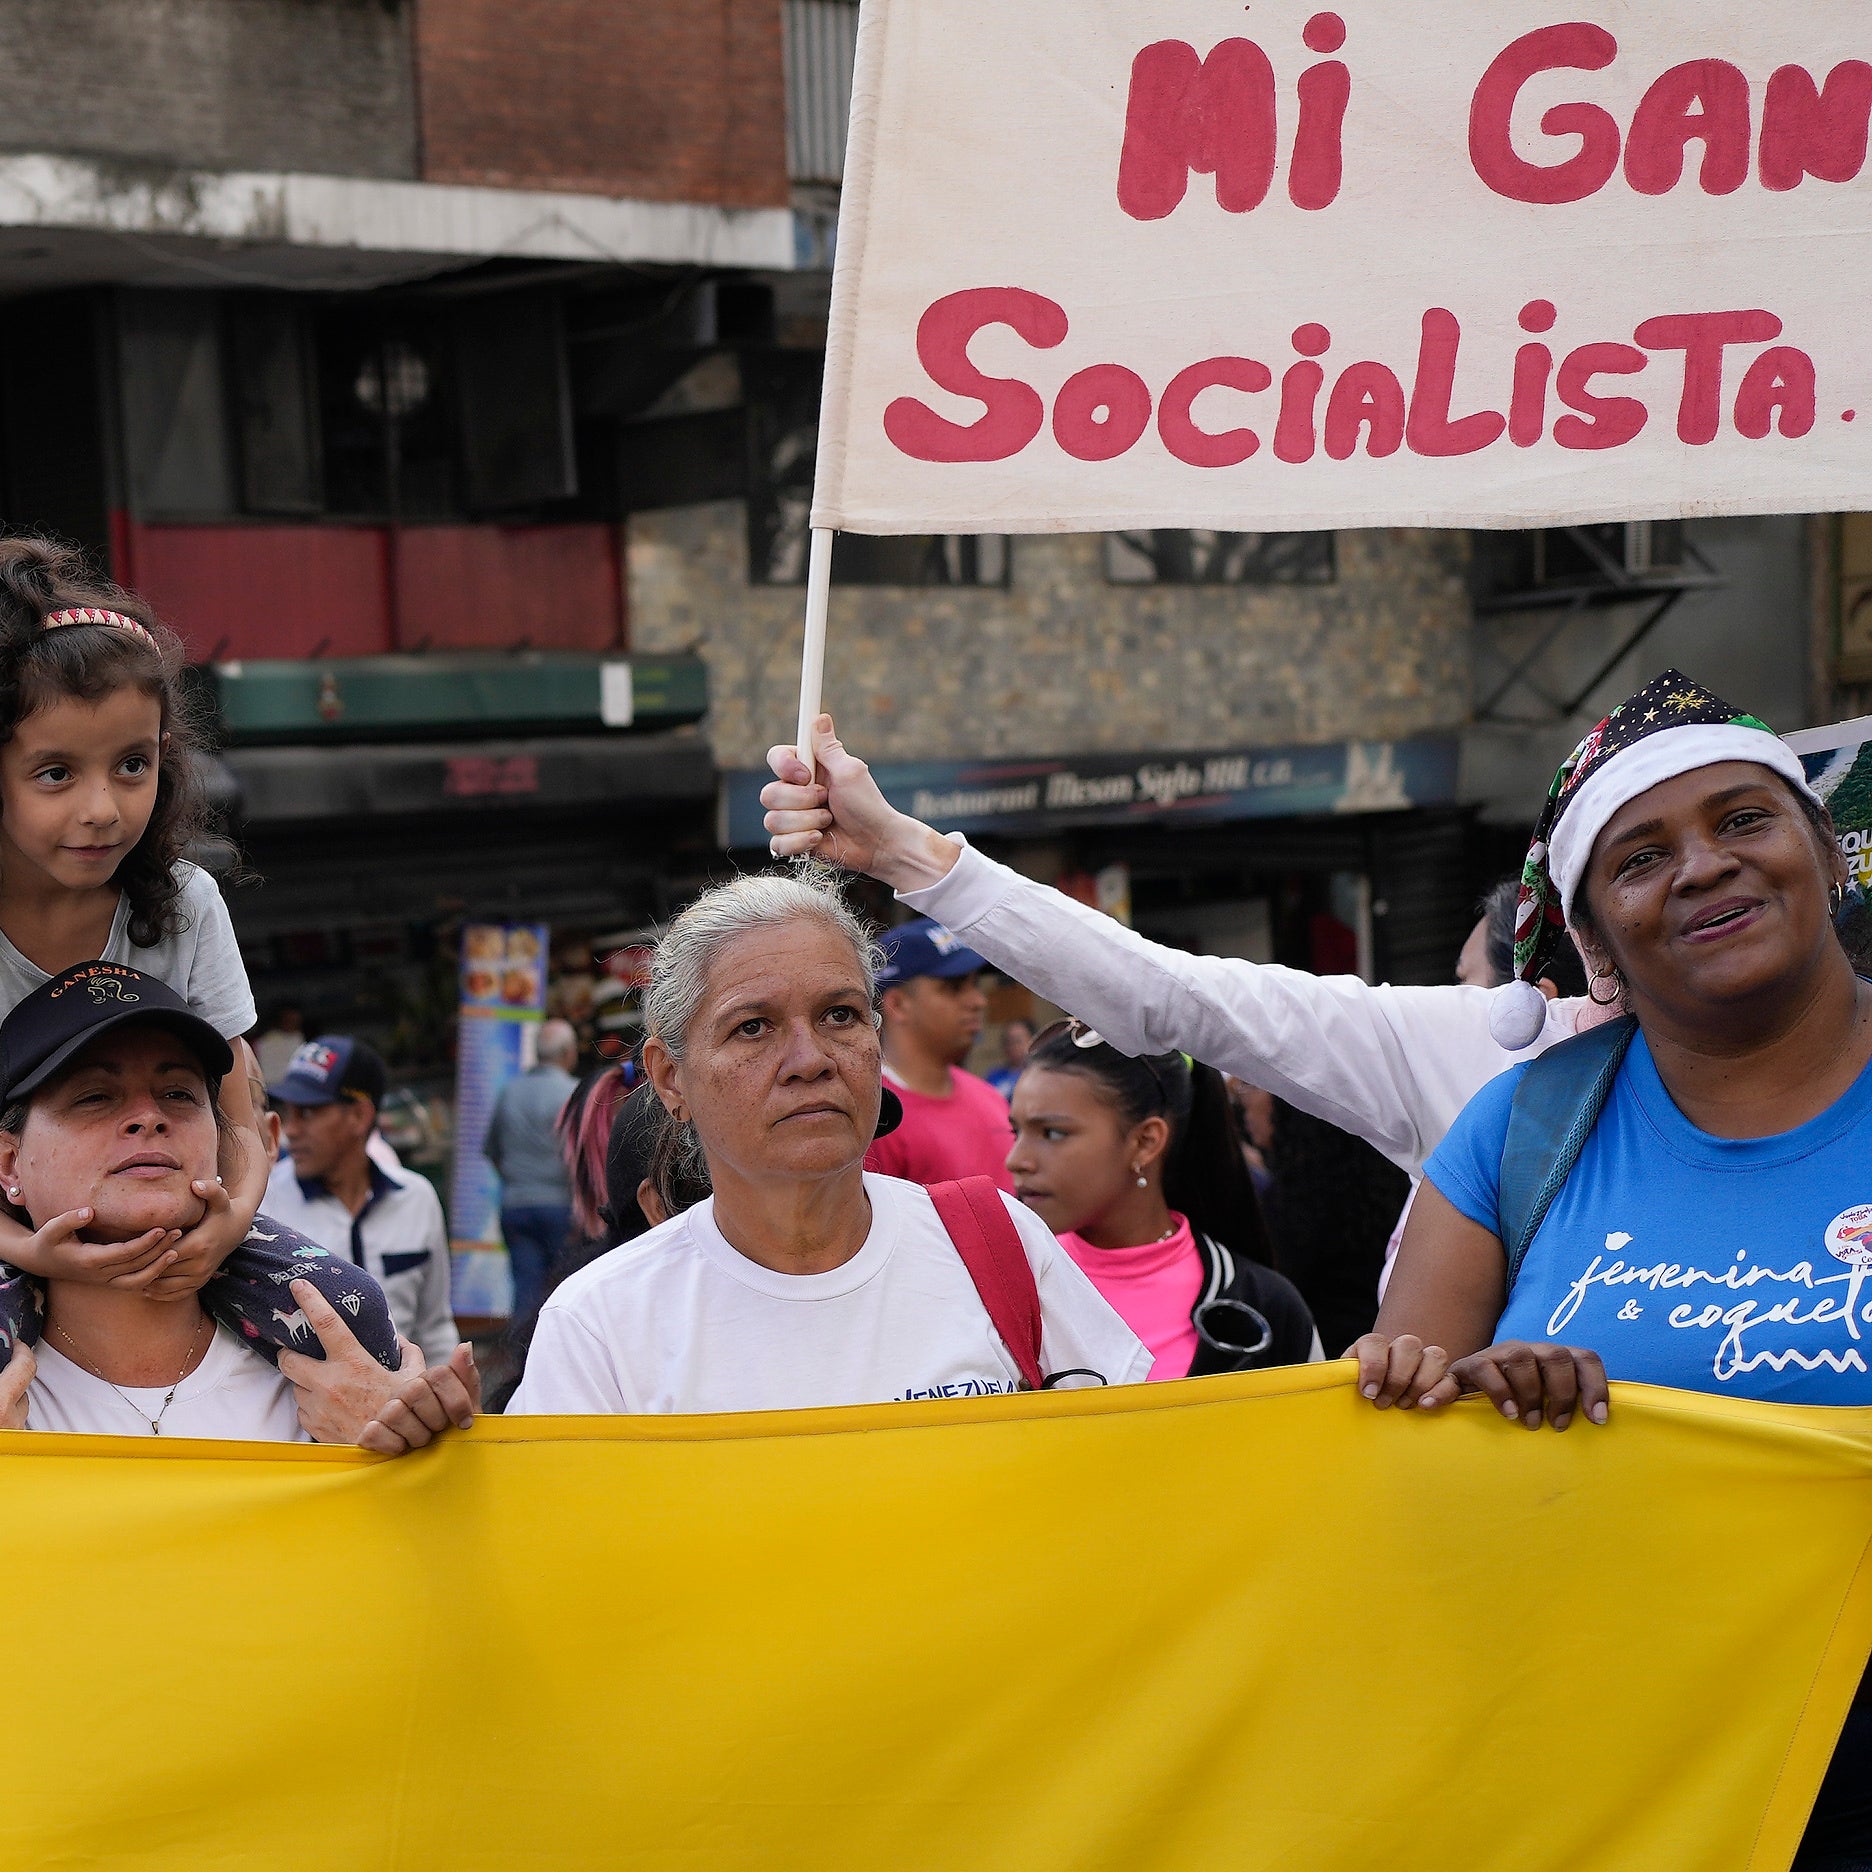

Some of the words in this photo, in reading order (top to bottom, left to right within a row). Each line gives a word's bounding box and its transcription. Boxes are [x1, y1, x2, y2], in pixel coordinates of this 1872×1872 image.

[50, 965, 141, 998] GANESHA
[1547, 1232, 1816, 1336] femenina
[1617, 1298, 1644, 1320] &
